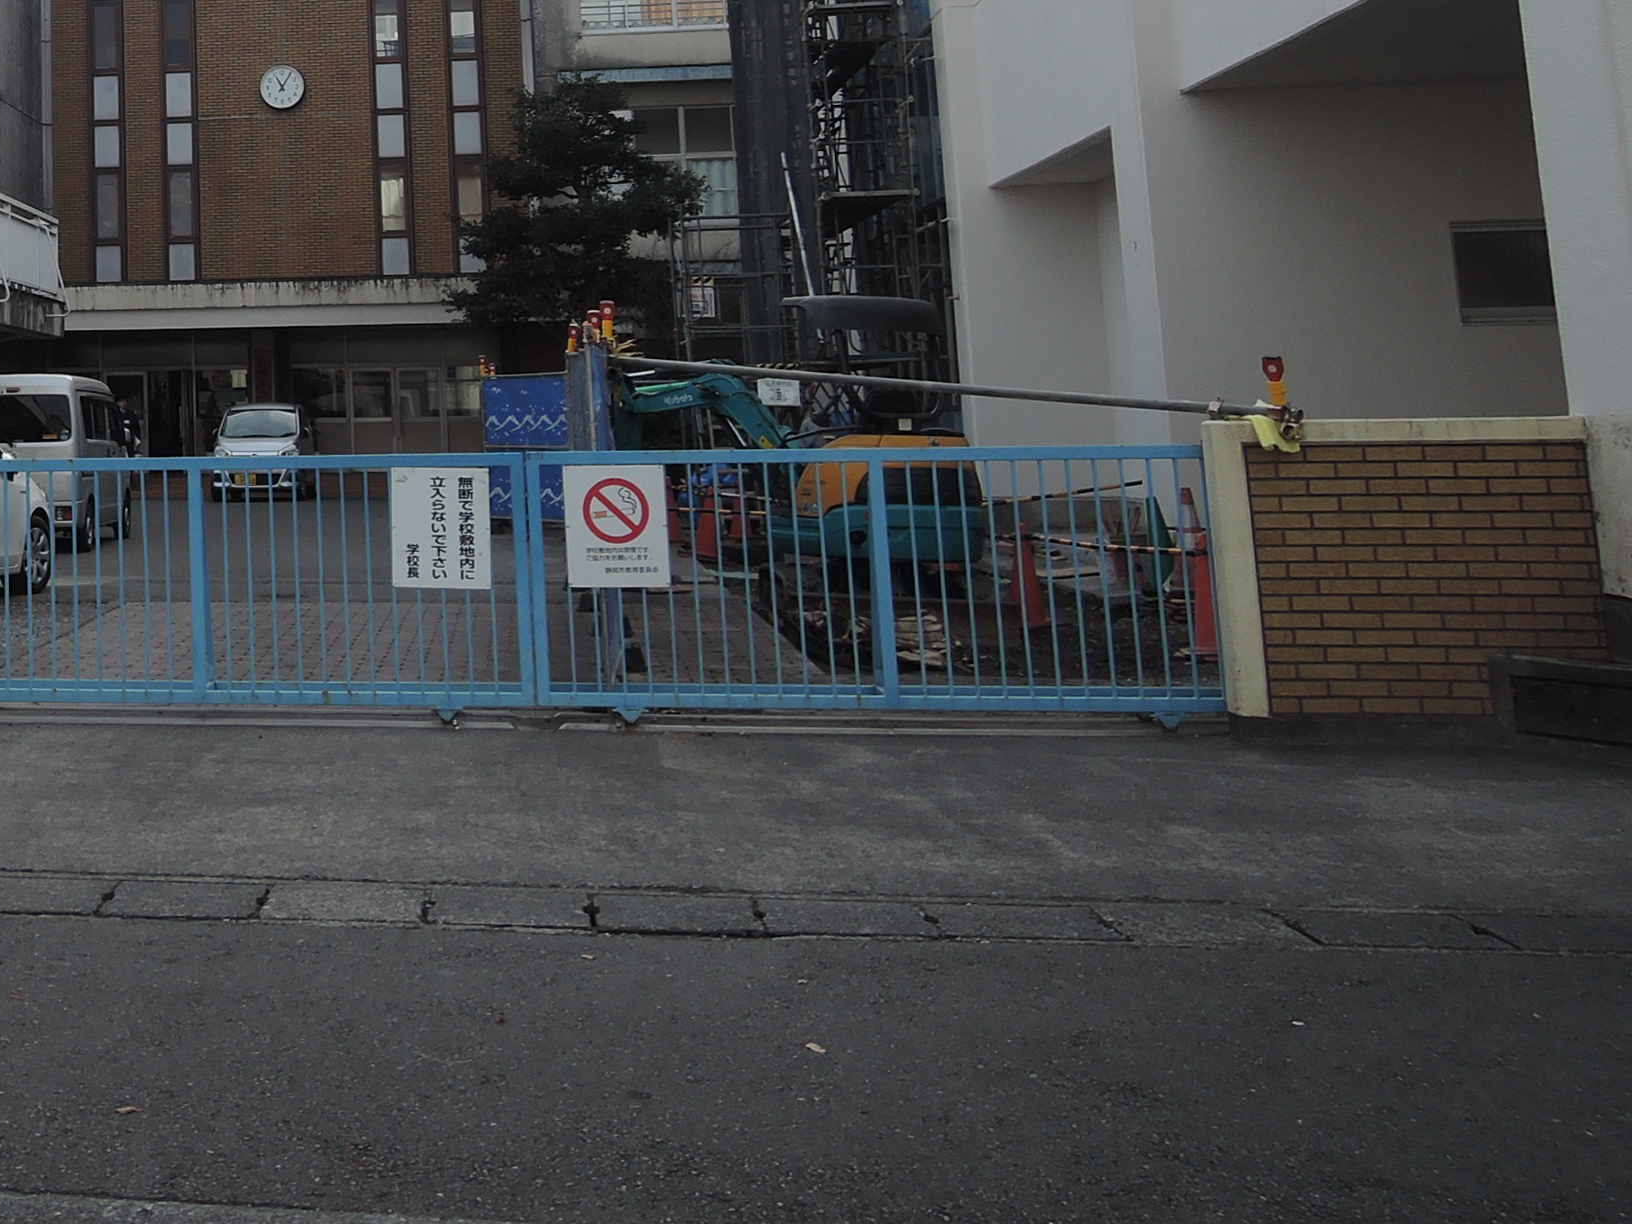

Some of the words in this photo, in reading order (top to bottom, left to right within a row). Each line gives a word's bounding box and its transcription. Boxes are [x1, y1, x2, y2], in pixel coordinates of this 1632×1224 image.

[406, 543, 420, 579] 学校長
[430, 476, 448, 580] 立入らないで下さい
[457, 477, 475, 581] 無断で学校敷地内に
